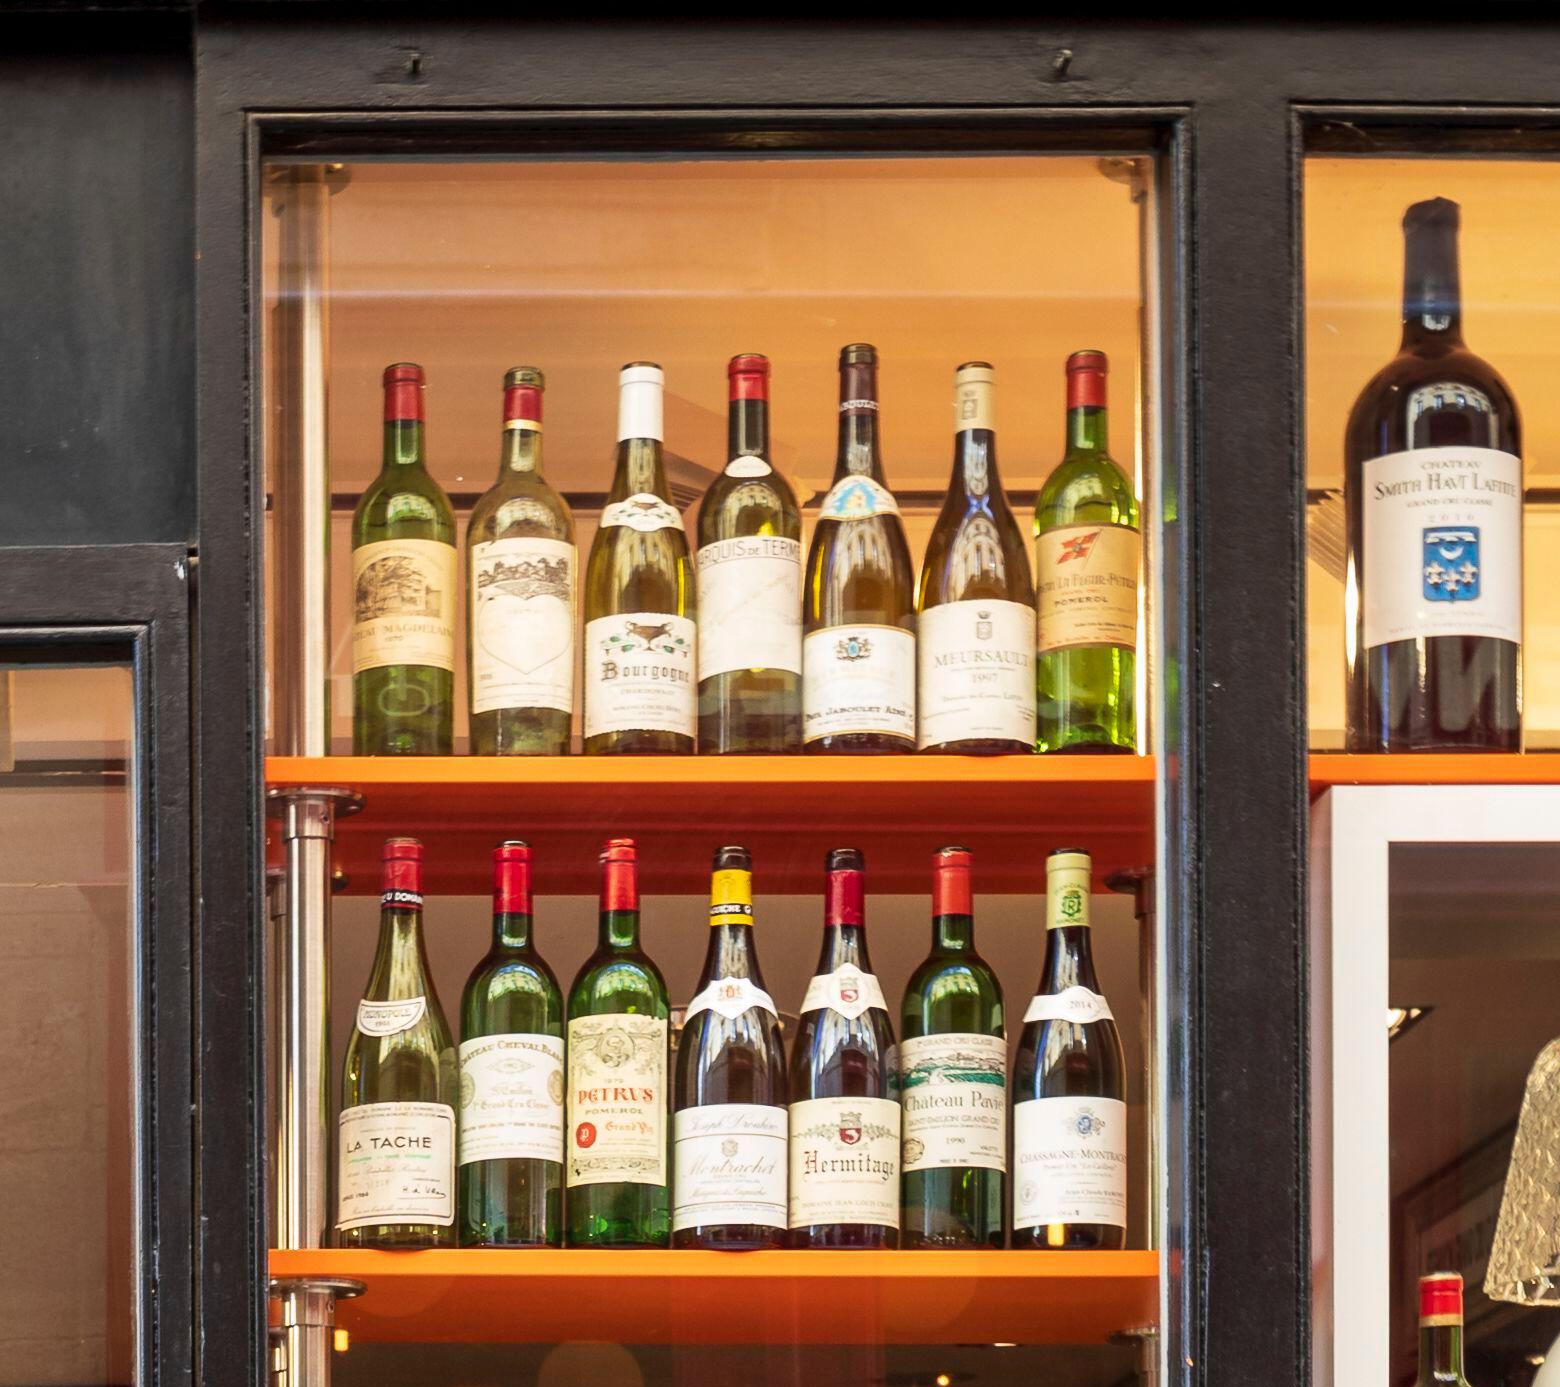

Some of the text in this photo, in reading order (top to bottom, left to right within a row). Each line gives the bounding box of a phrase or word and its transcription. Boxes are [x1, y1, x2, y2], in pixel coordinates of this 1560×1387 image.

[1055, 596, 1108, 607] POMEROL
[934, 649, 1028, 667] MEURSAULT
[601, 661, 689, 682] Bourgogne
[971, 1090, 1003, 1111] Pavie
[347, 1136, 432, 1154] LA TACHE
[804, 1149, 895, 1182] Hermitage
